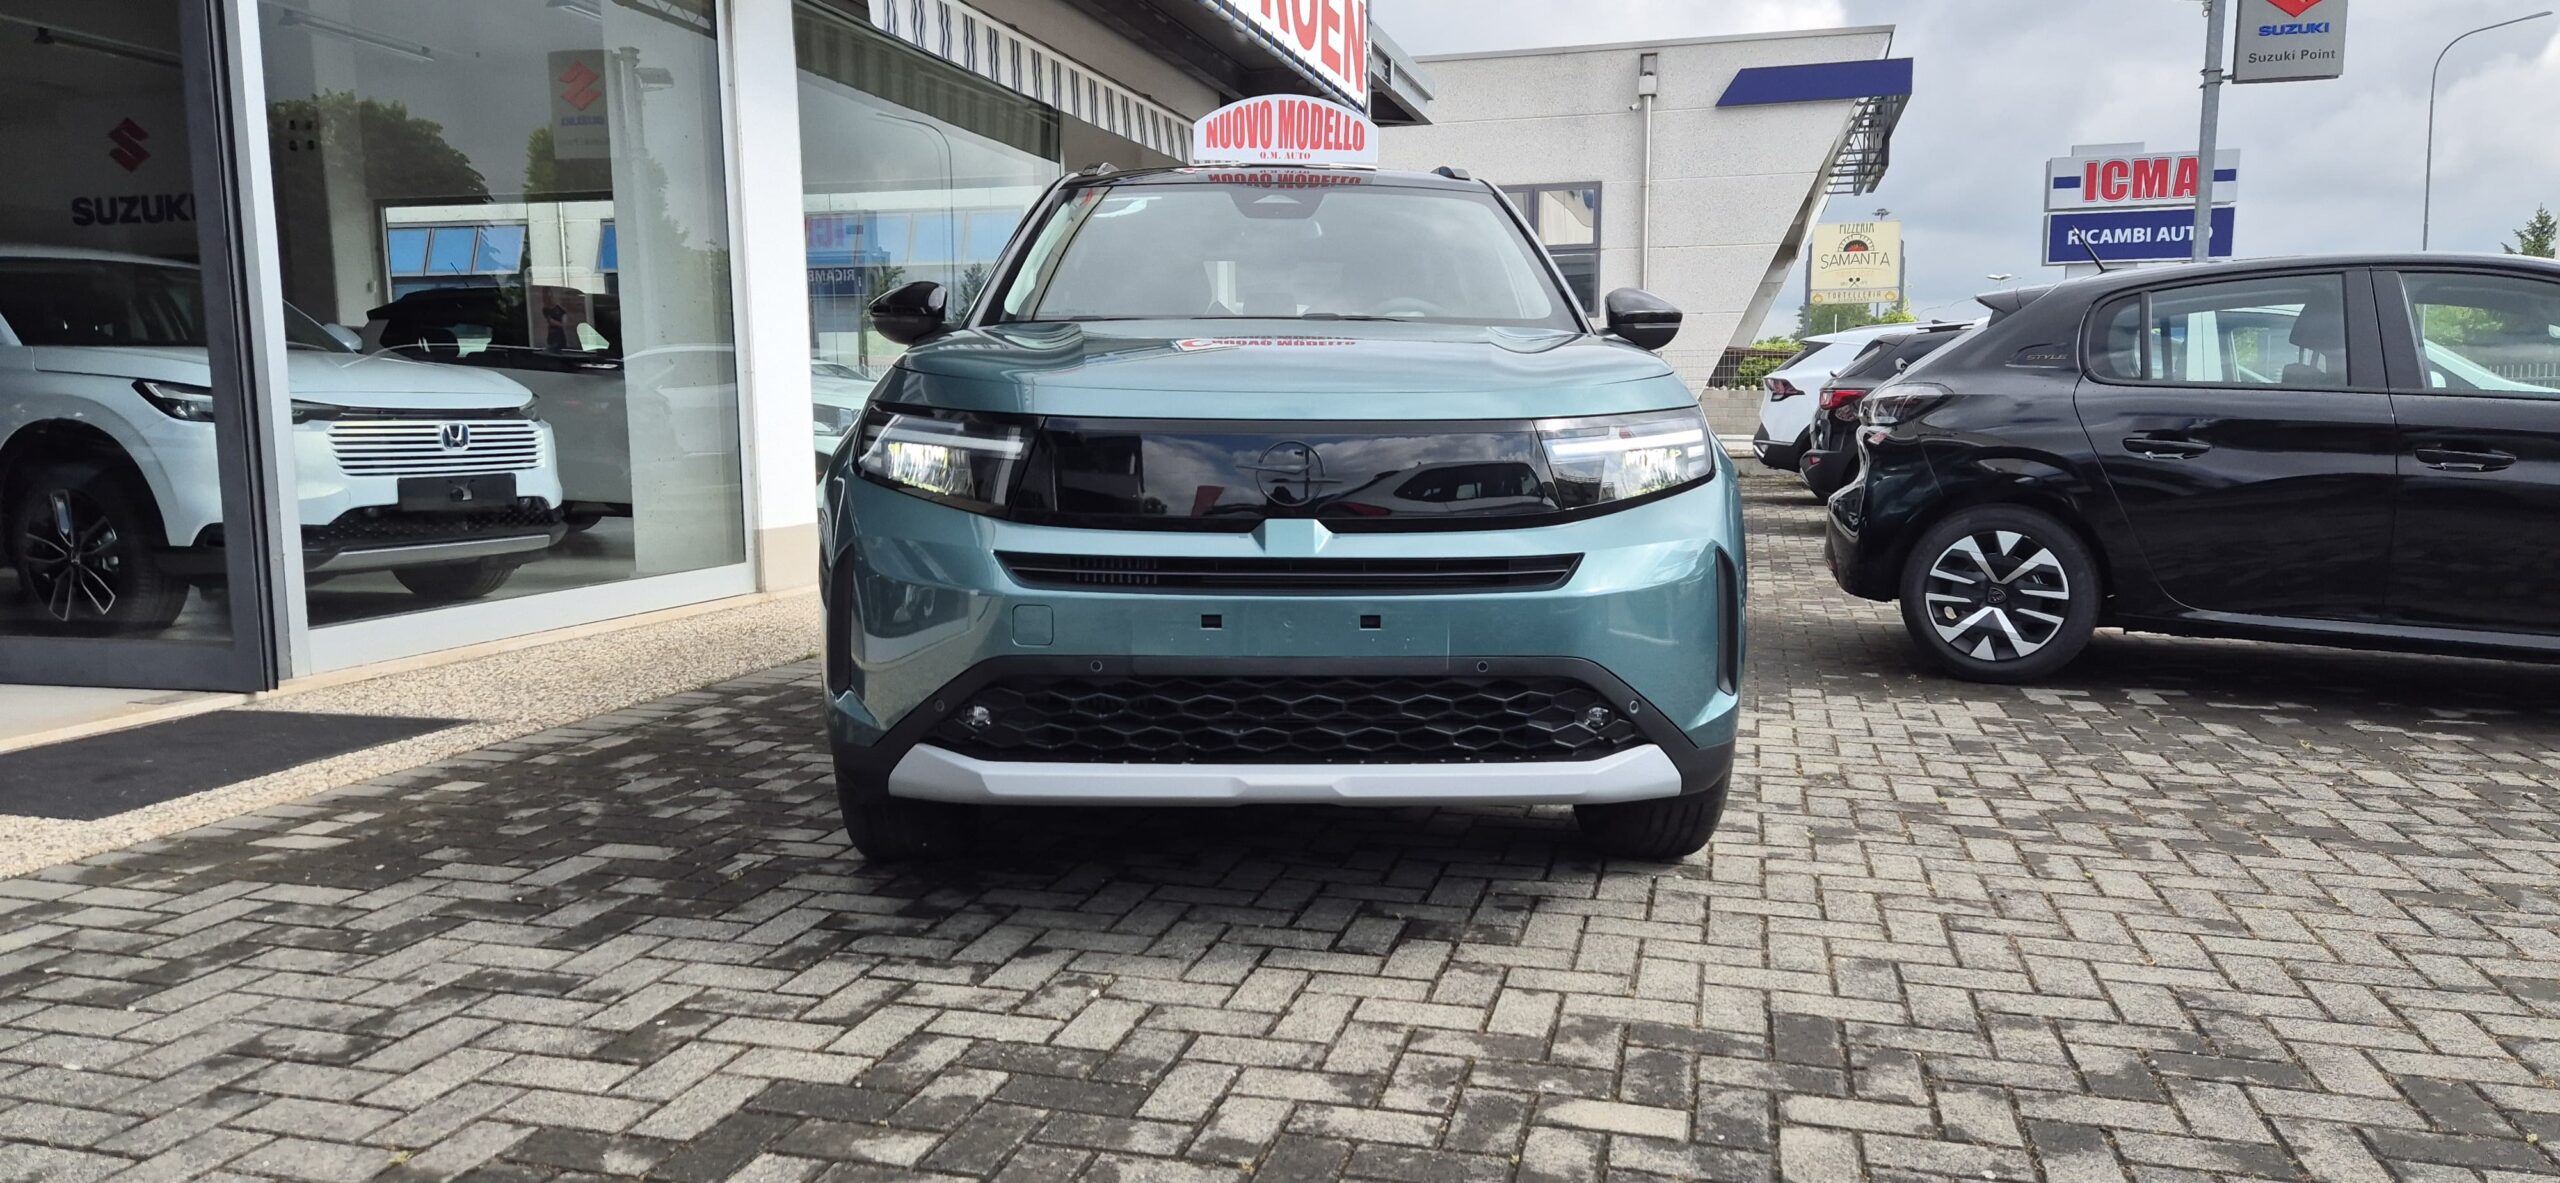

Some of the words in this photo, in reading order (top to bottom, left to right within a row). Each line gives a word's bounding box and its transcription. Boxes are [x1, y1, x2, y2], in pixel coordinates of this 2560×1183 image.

[2258, 22, 2330, 36] SUZUKI
[2248, 50, 2296, 63] Suzuki
[2300, 48, 2336, 60] Point
[1205, 100, 1273, 150] NUOVO
[1278, 99, 1365, 152] MODELLO
[1284, 152, 1311, 160] AUTO
[2083, 156, 2200, 203] ICMA
[1839, 223, 1875, 234] PIZZERIA
[2067, 227, 2151, 245] RICAMBI
[2156, 225, 2213, 243] AUT
[1820, 252, 1890, 270] SAMANTA
